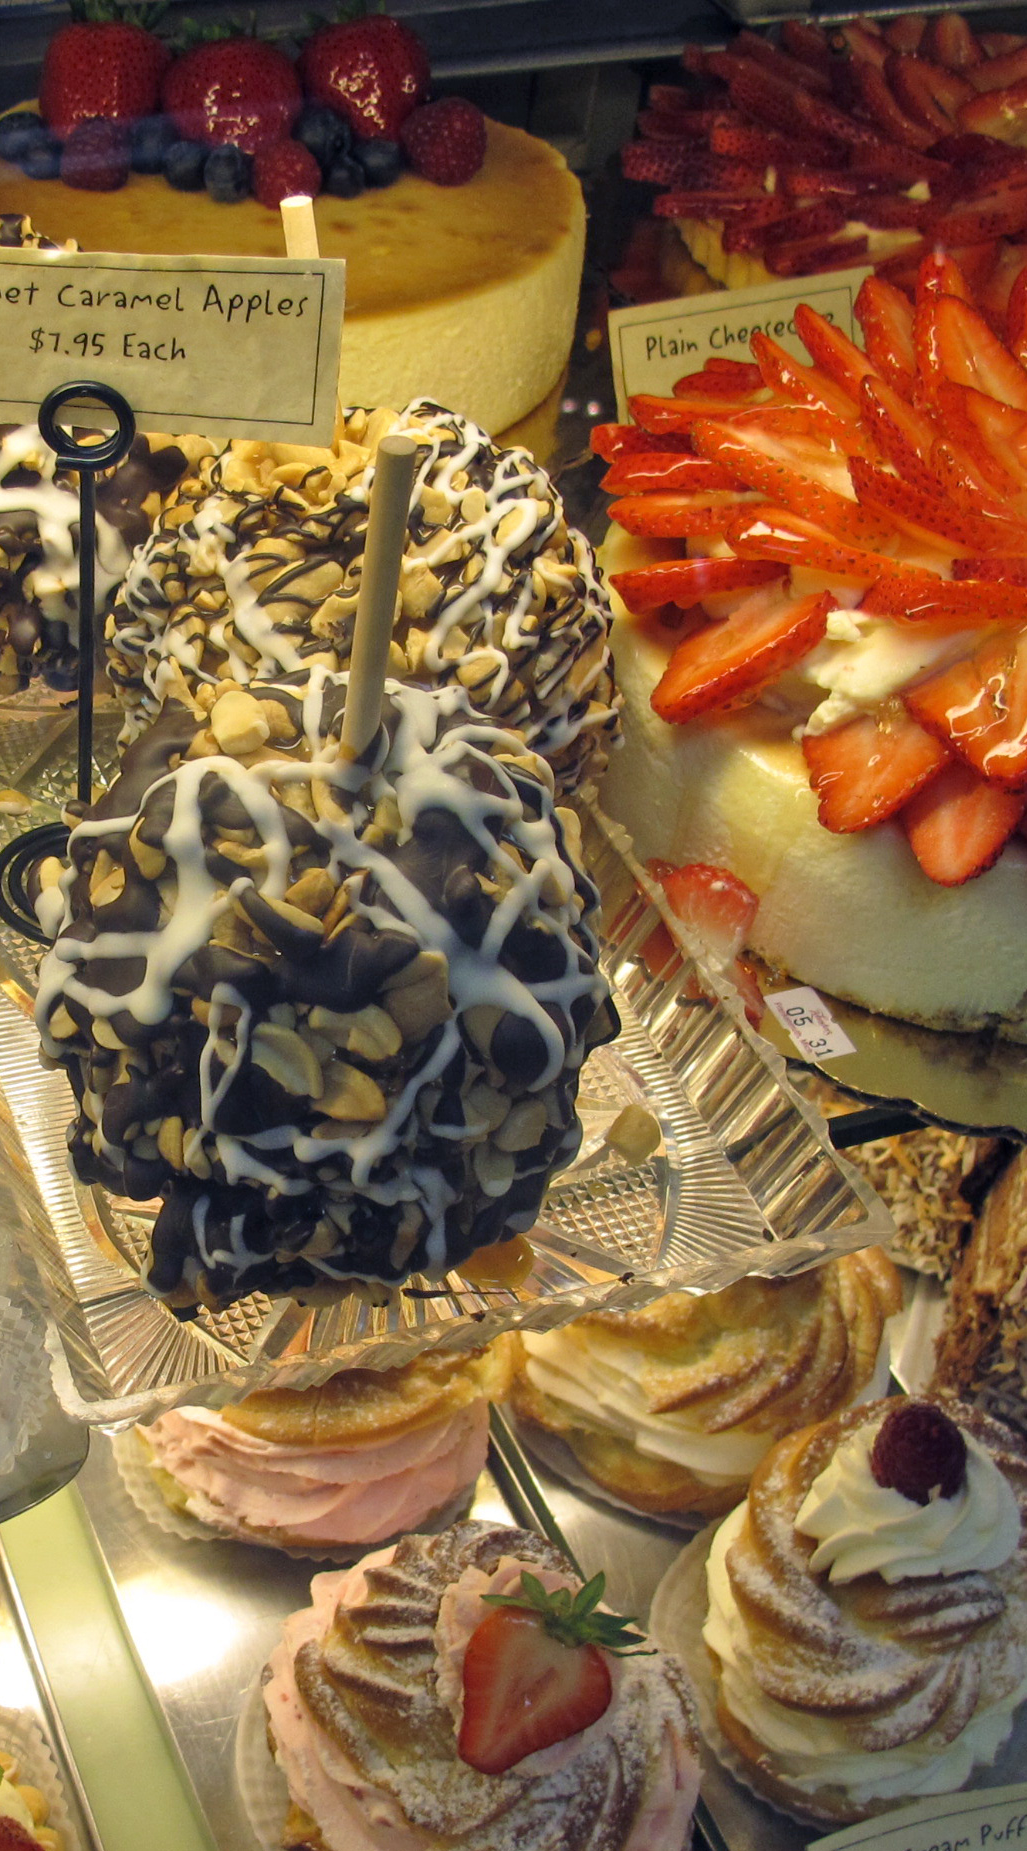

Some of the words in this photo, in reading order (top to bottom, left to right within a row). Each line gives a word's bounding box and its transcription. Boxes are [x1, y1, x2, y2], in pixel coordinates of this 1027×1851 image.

[58, 284, 185, 312] Caramel
[202, 284, 309, 323] Apples
[29, 327, 105, 357] $7.95
[122, 333, 187, 361] Each
[646, 328, 698, 361] Plain
[786, 1006, 814, 1027] 05
[808, 1038, 834, 1058] 31
